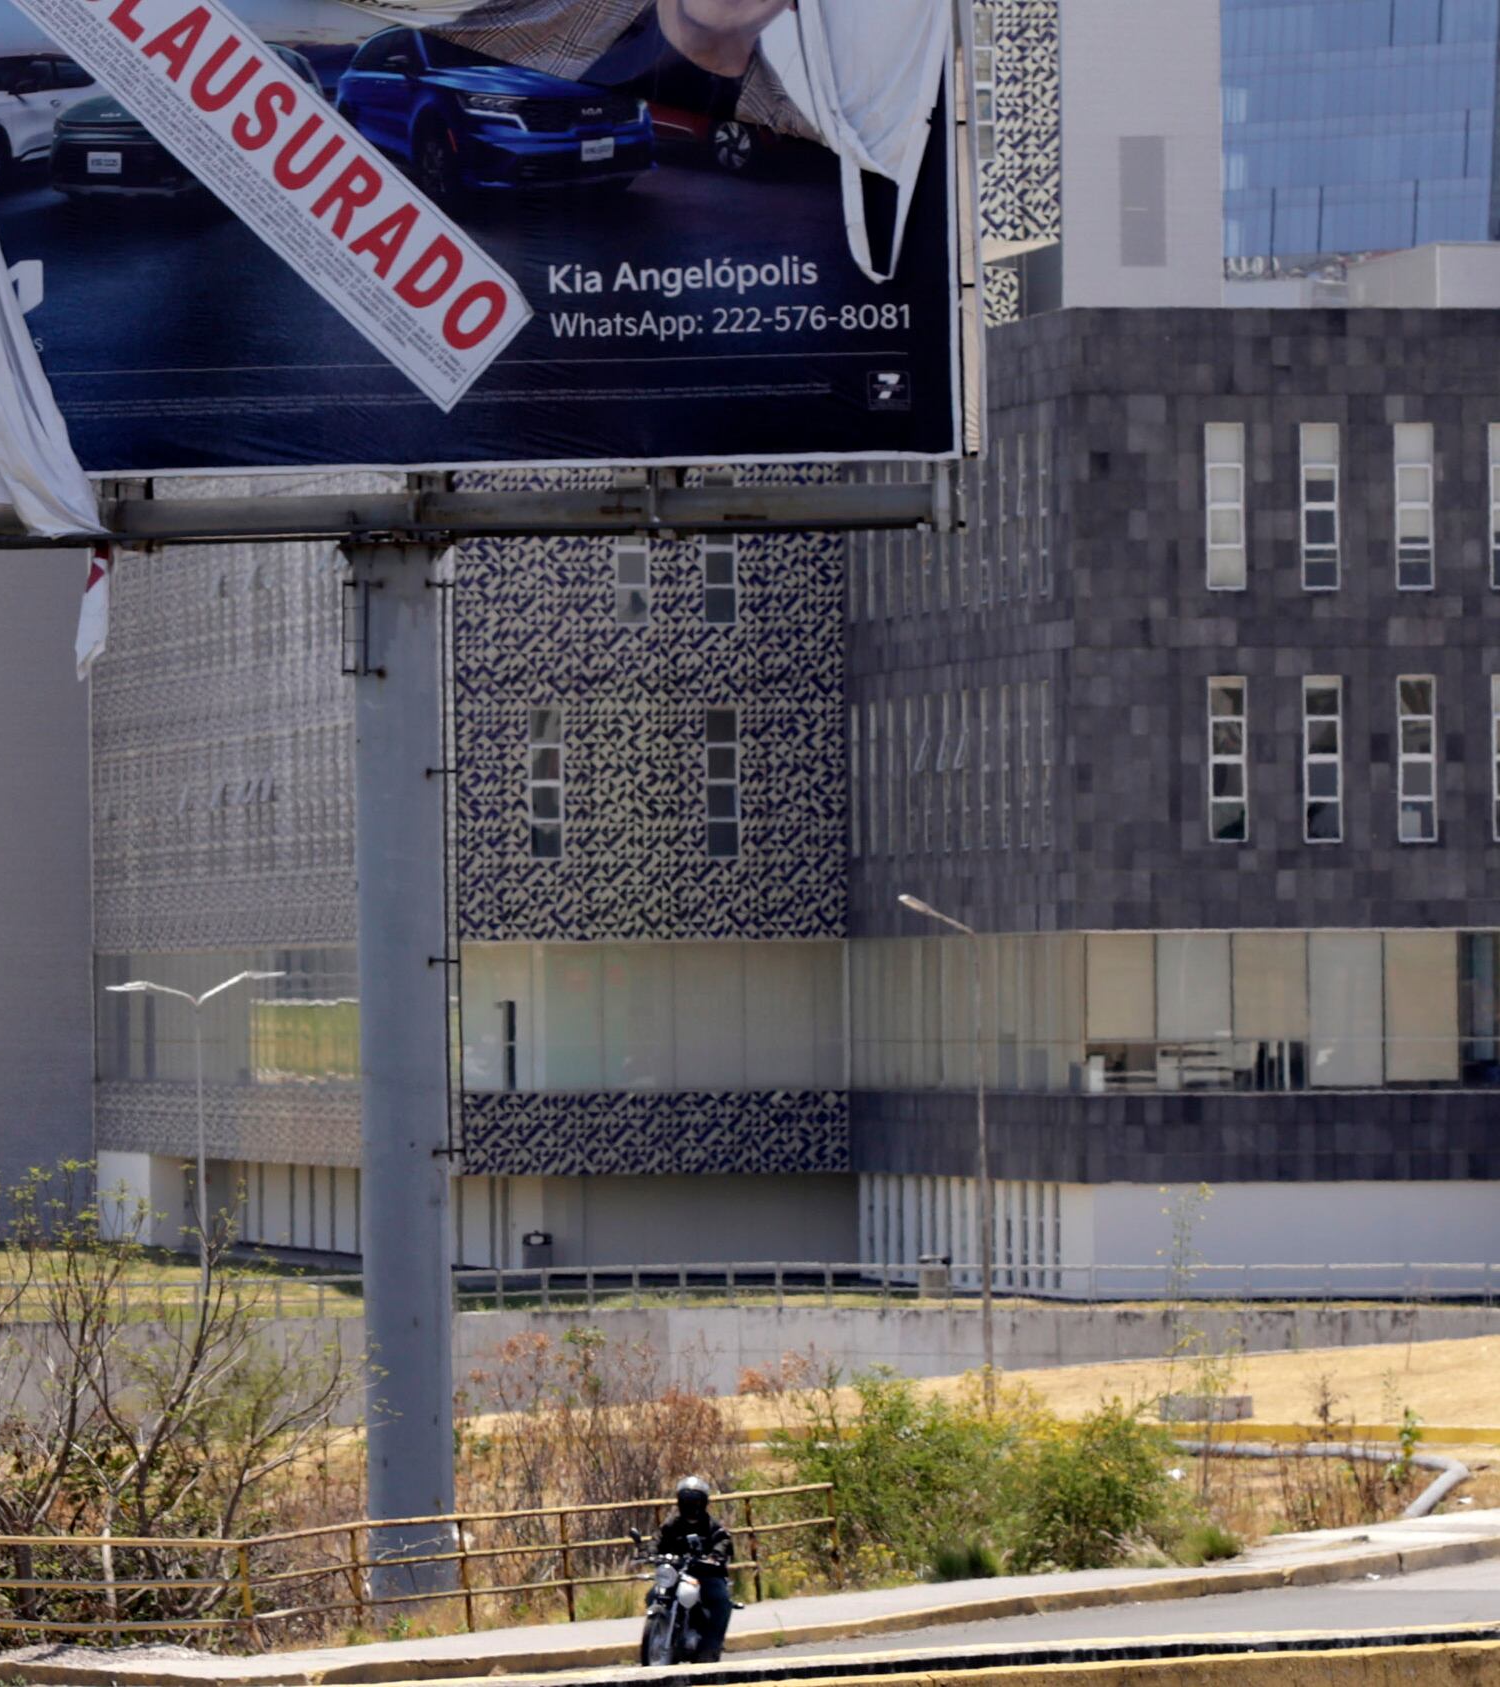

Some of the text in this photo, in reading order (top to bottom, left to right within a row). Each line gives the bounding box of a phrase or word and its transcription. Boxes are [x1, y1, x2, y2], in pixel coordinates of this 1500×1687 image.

[87, 0, 508, 350] LAUSURADO
[548, 254, 818, 298] Kia Angelópolis
[550, 303, 911, 341] WhatsApp: 222-576-8081
